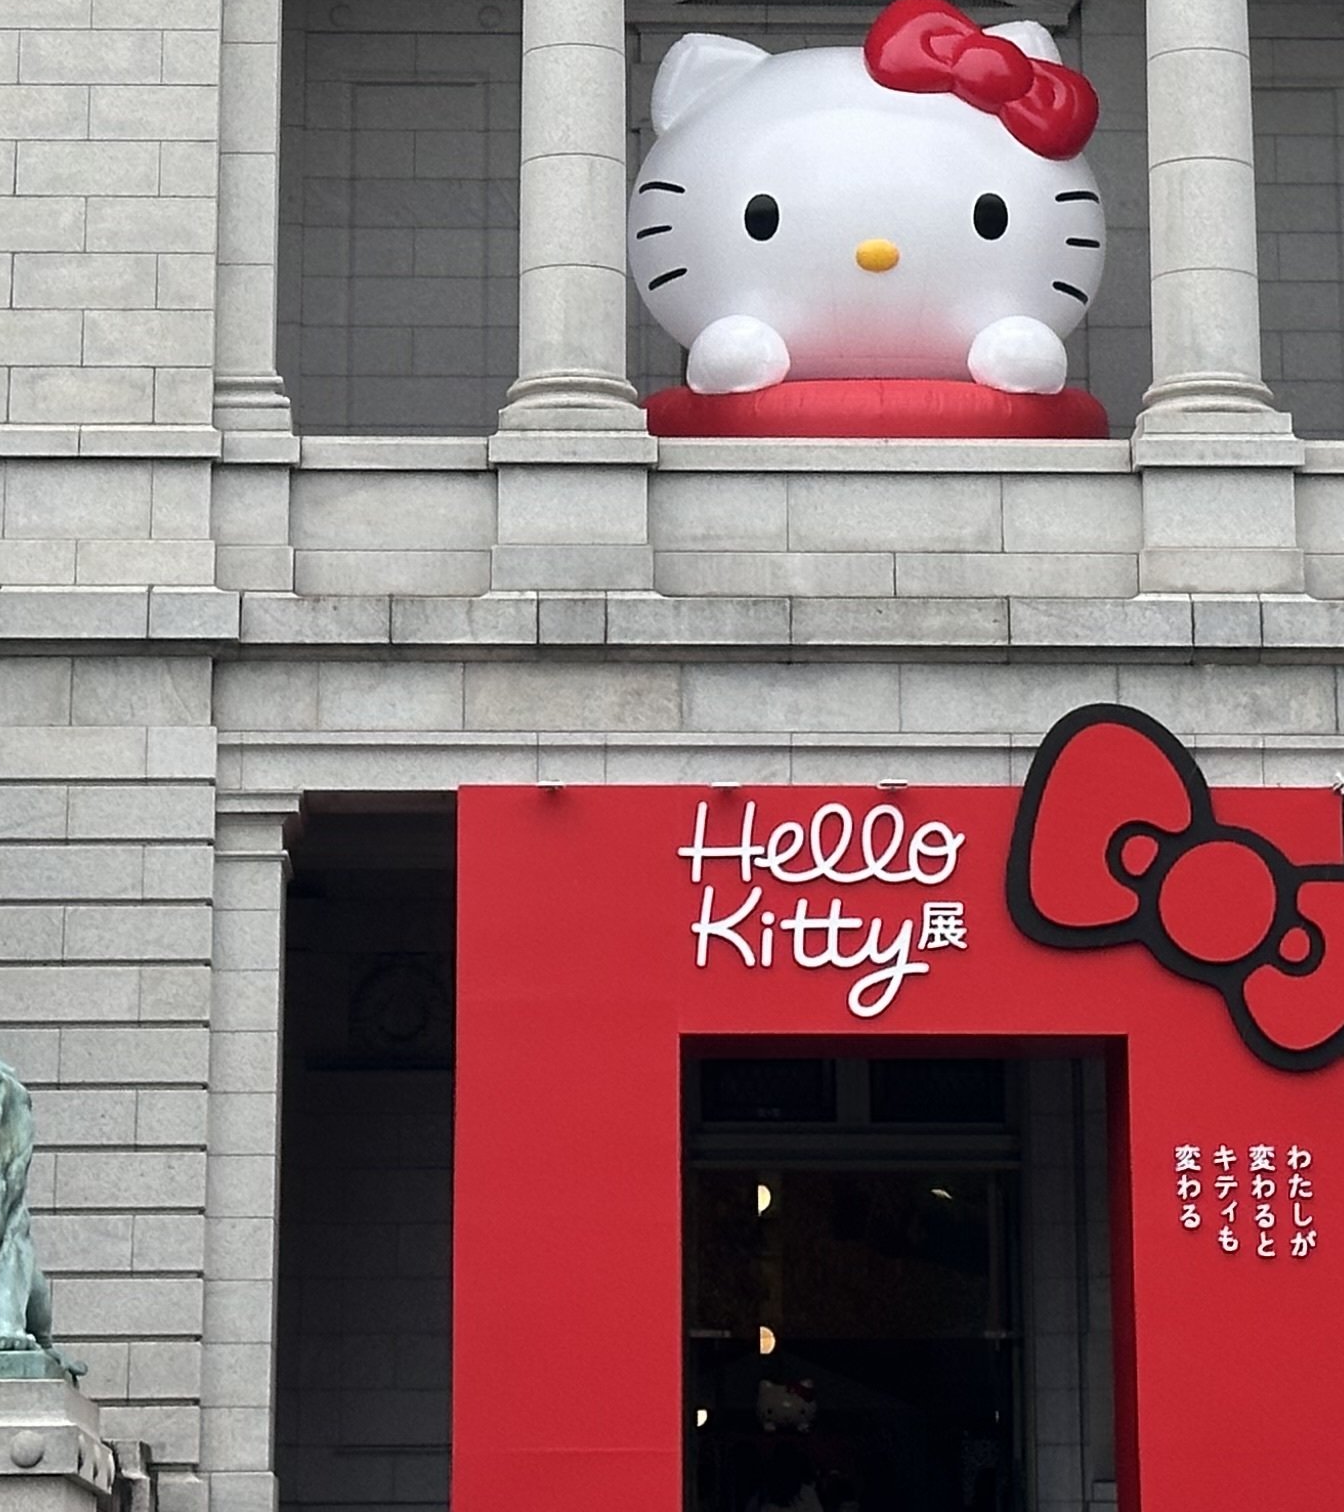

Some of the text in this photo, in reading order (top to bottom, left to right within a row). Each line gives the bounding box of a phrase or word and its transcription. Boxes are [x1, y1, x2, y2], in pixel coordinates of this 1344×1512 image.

[677, 800, 966, 885] Hello
[690, 885, 968, 1017] Kitty 展
[1174, 1144, 1202, 1229] 変わる
[1213, 1144, 1239, 1252] キティも
[1248, 1143, 1276, 1257] 変わると
[1287, 1144, 1317, 1257] わたしが
